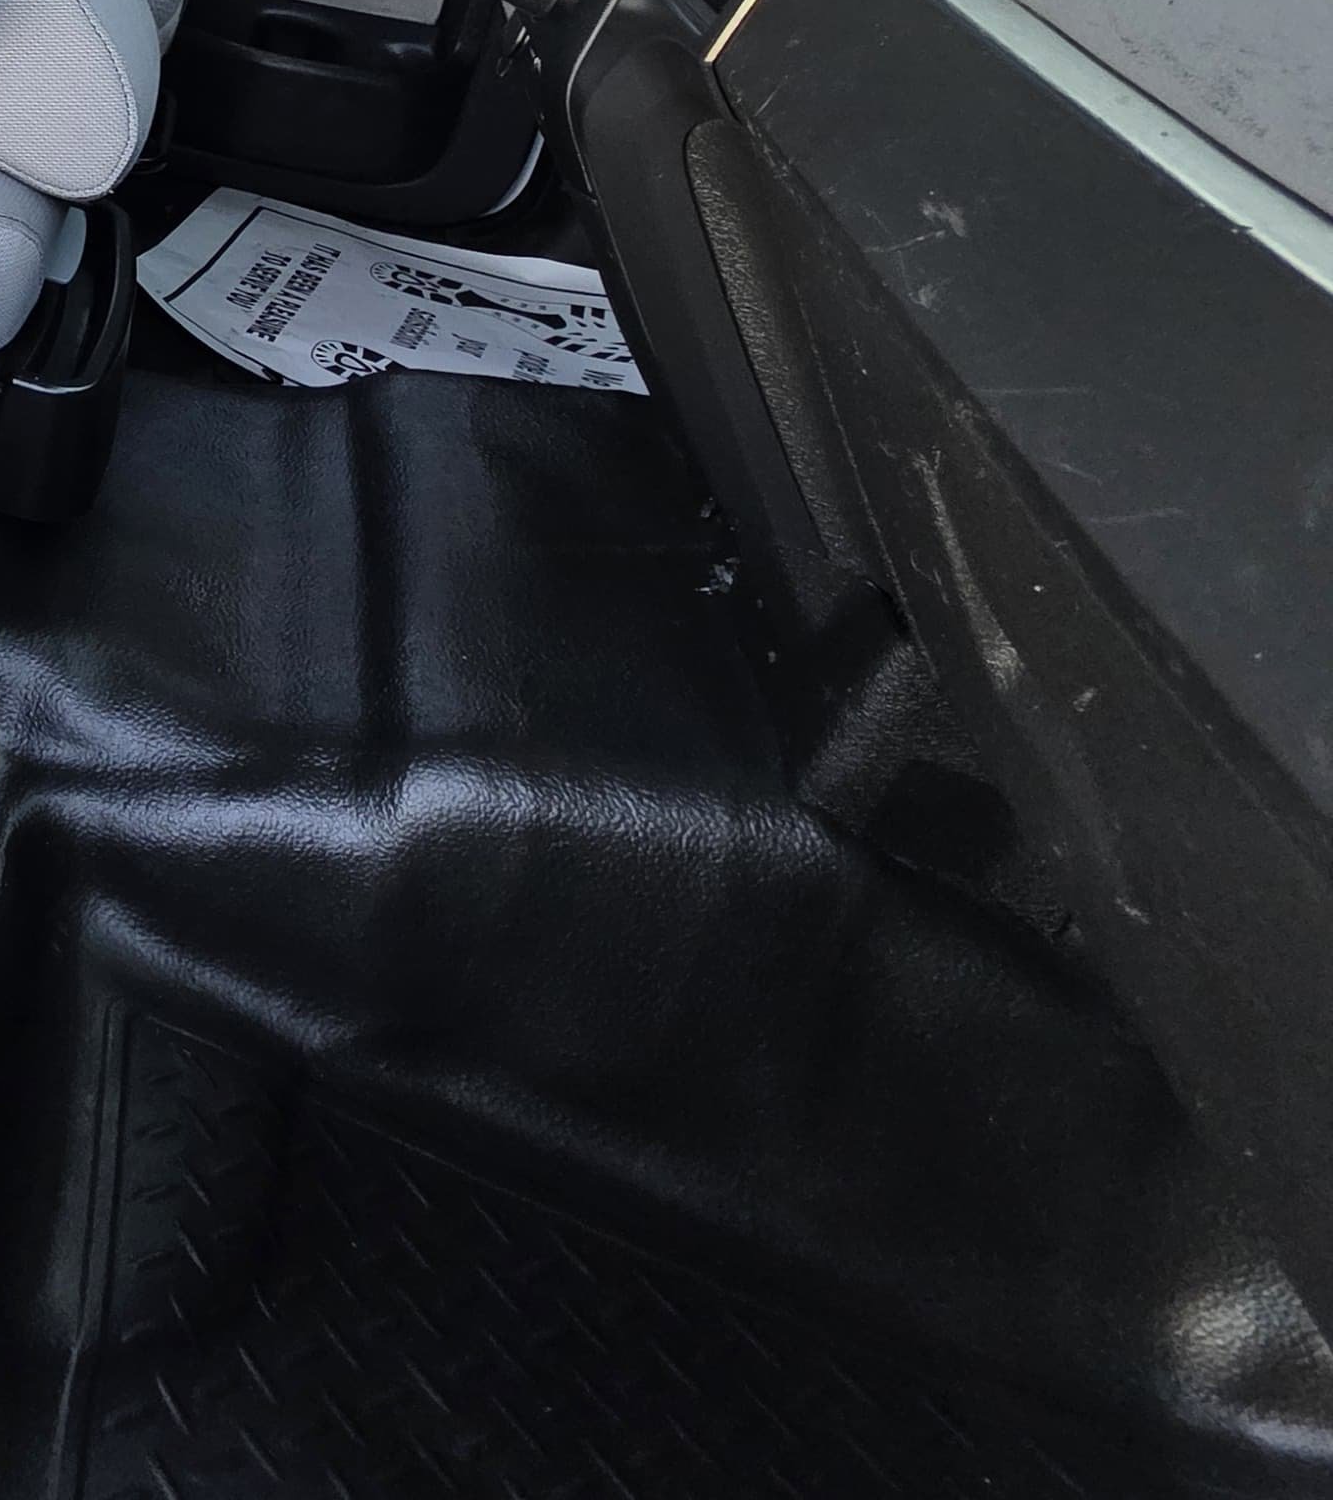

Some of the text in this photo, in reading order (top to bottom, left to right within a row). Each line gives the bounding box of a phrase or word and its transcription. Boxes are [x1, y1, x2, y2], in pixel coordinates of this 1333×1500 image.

[226, 250, 292, 309] TO SERVE YOU
[246, 243, 341, 342] IT HAS BEEN A PLEASURE
[389, 307, 440, 350] satisfaction
[452, 332, 488, 358] your
[513, 348, 557, 376] pride
